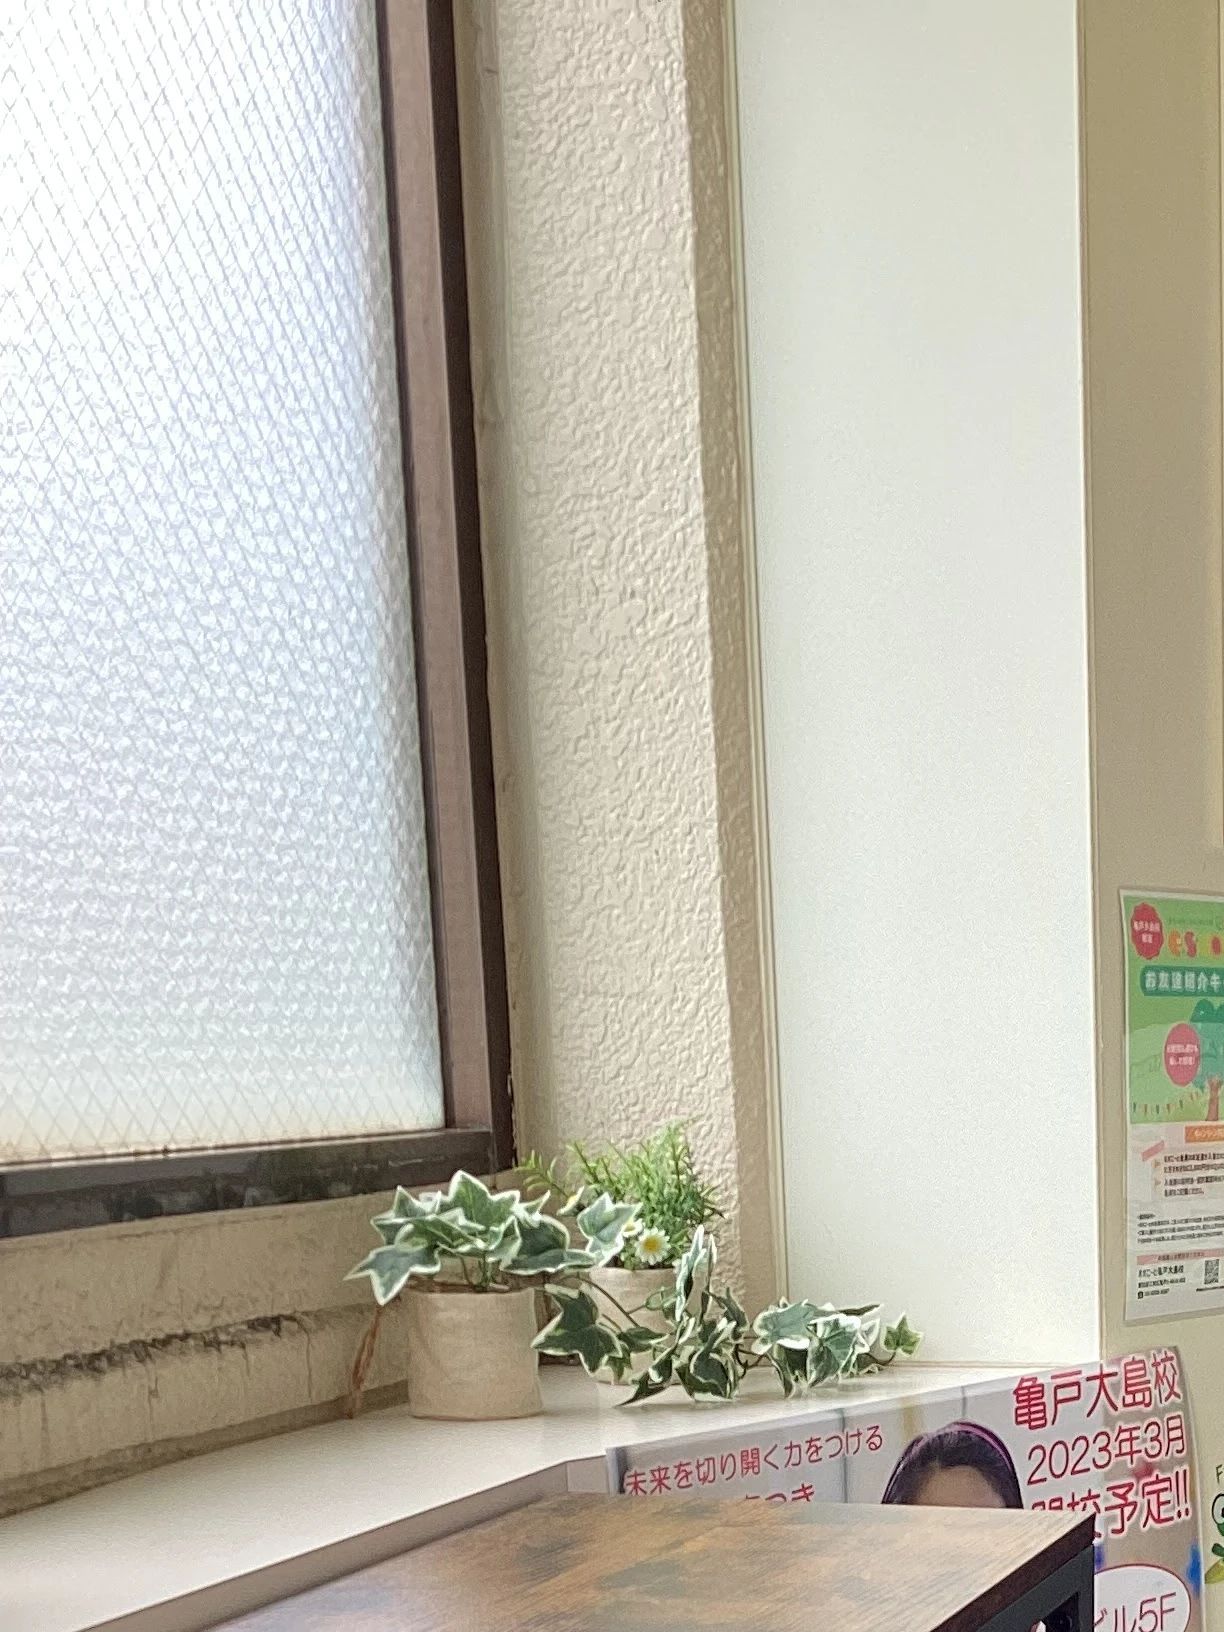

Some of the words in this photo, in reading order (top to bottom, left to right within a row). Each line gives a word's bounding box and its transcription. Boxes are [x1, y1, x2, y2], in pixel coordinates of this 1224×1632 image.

[1012, 1350, 1182, 1431] 亀戸大島校
[625, 1424, 884, 1496] 未来を切り開く力をつける
[1027, 1414, 1186, 1487] 2023年3月
[1032, 1469, 1191, 1538] 予定!!
